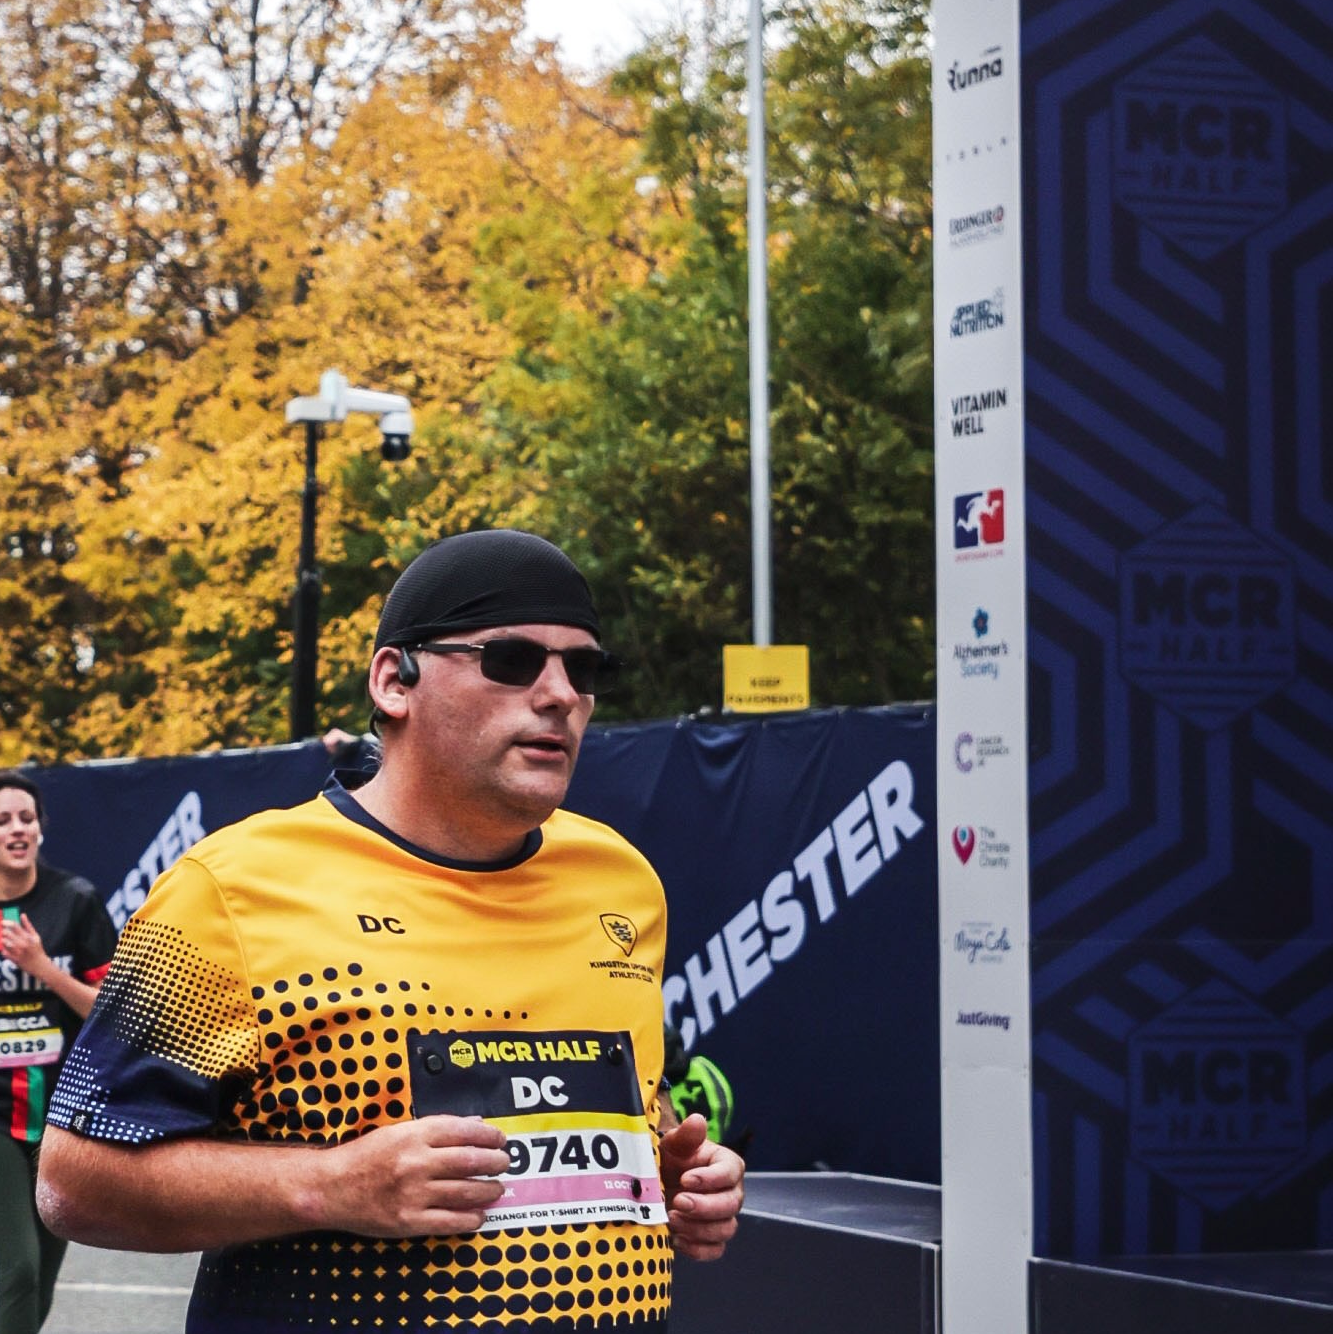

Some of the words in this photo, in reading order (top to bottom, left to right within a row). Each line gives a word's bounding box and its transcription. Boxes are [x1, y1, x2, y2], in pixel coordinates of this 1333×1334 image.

[1124, 100, 1274, 162] MCR
[1150, 163, 1251, 194] HALF
[951, 387, 1007, 415] VITAMIN
[951, 415, 984, 437] WELL
[1133, 570, 1281, 631] MCR
[952, 641, 1009, 660] Alzheimer's
[1160, 634, 1259, 664] HALF
[961, 662, 998, 680] Society
[357, 914, 406, 934] DC
[589, 960, 630, 969] KINGSTON
[609, 970, 642, 980] ATHLETIC
[956, 1010, 1010, 1031] JustGiving
[476, 1041, 535, 1063] MCR
[535, 1040, 601, 1062] HALF
[1142, 1049, 1292, 1105] MCR
[511, 1075, 569, 1109] DC
[1168, 1113, 1268, 1142] HALF
[529, 1210, 548, 1218] FOR
[550, 1207, 583, 1216] T-SHIRT
[599, 1205, 626, 1213] FINISH
